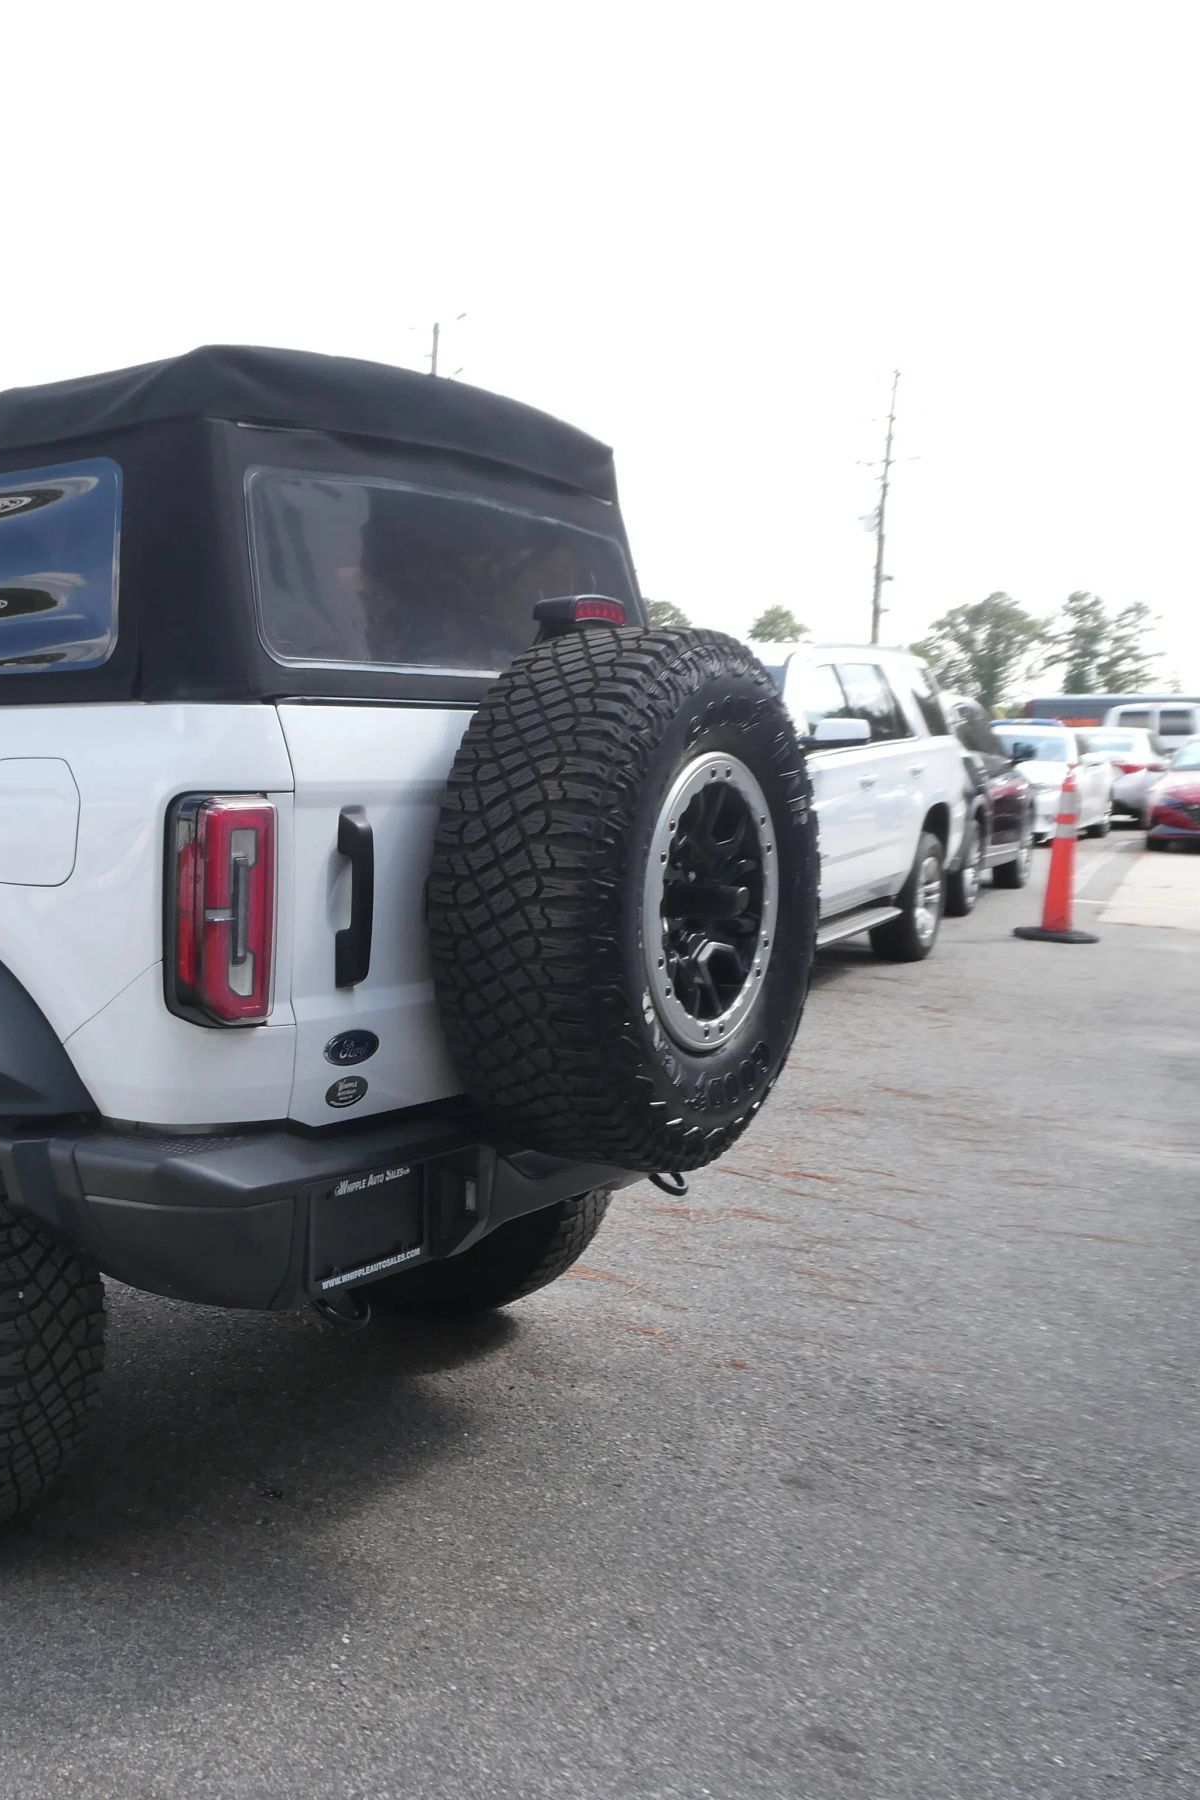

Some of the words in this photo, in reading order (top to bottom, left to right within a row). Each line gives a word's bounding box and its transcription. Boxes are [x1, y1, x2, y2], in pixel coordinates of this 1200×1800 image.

[367, 1173, 385, 1187] AUTO
[385, 1167, 404, 1182] SALES
[321, 1247, 421, 1290] WWW.WHIPPLEAUTOSALES.COM
